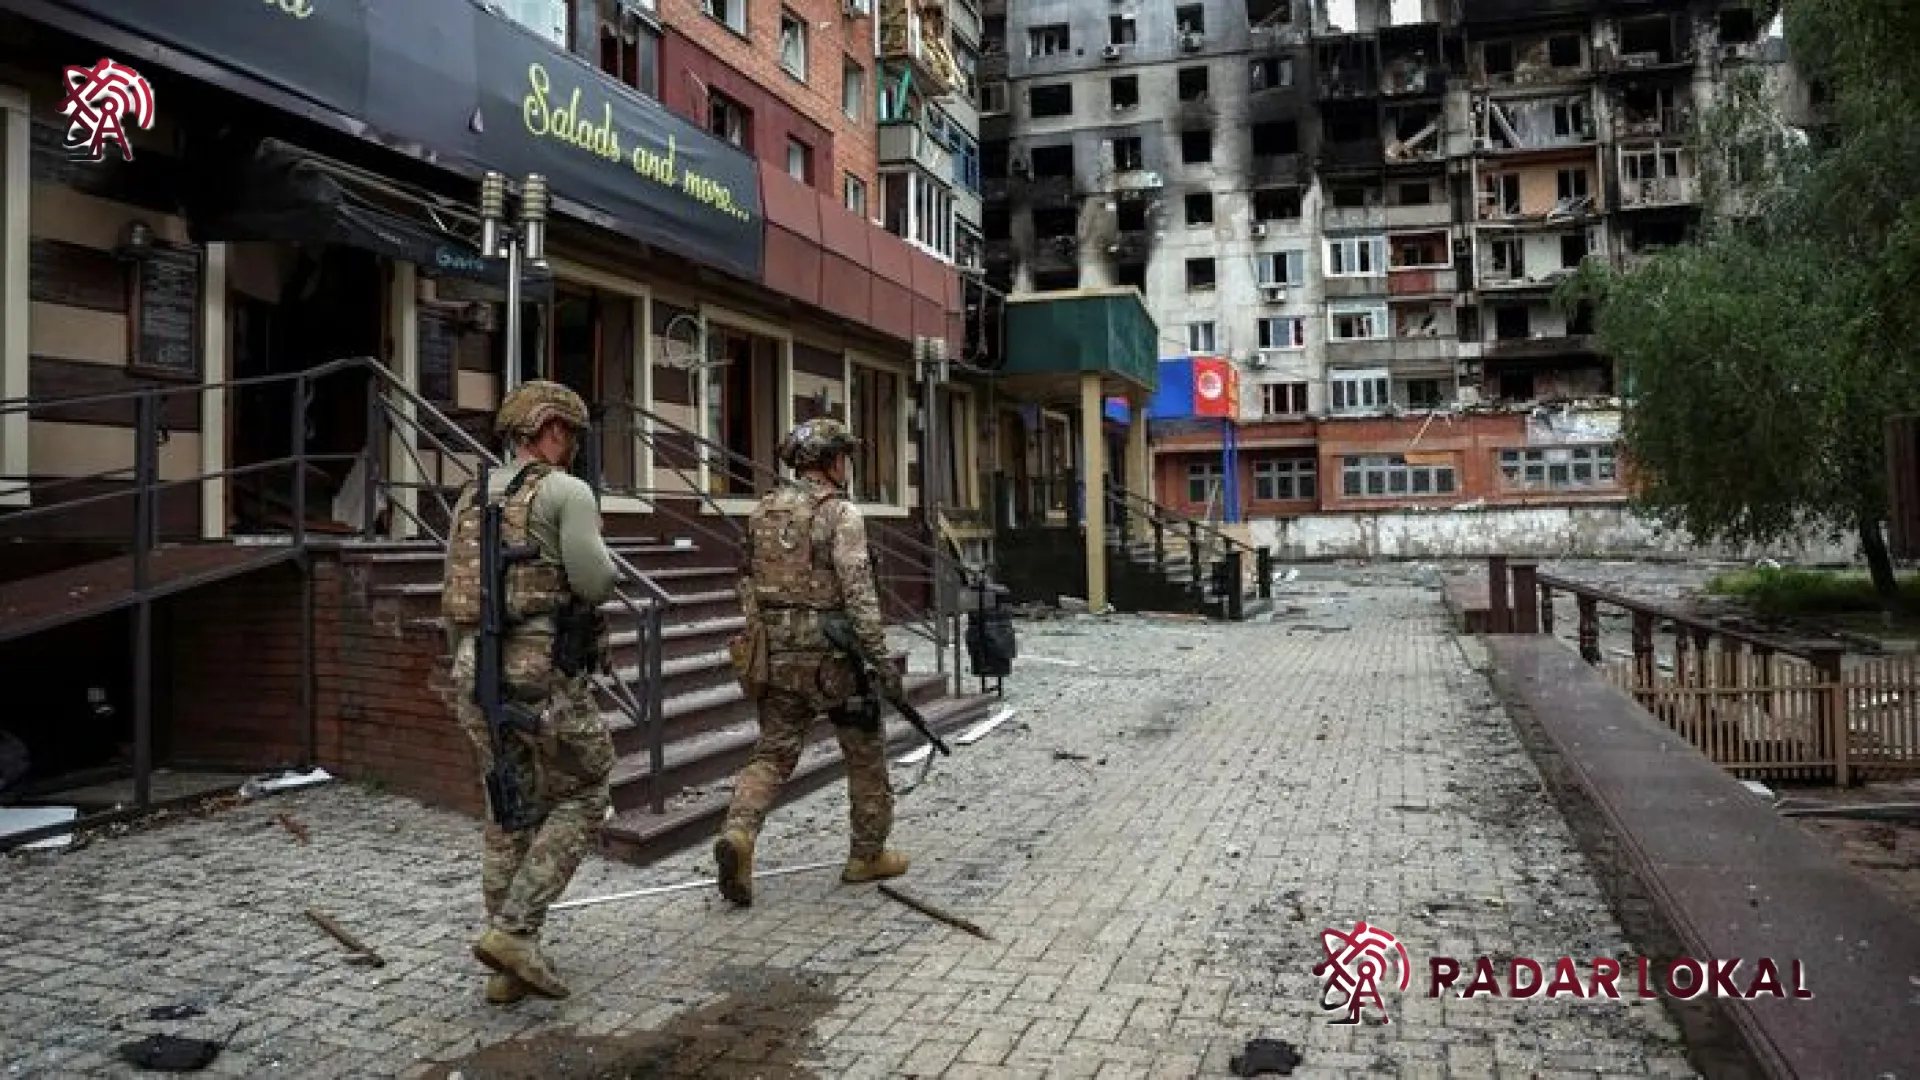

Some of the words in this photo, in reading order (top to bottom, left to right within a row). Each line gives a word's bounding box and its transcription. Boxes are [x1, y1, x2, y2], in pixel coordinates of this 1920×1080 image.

[524, 62, 621, 162] Salads
[632, 133, 676, 187] and
[682, 169, 750, 222] more...
